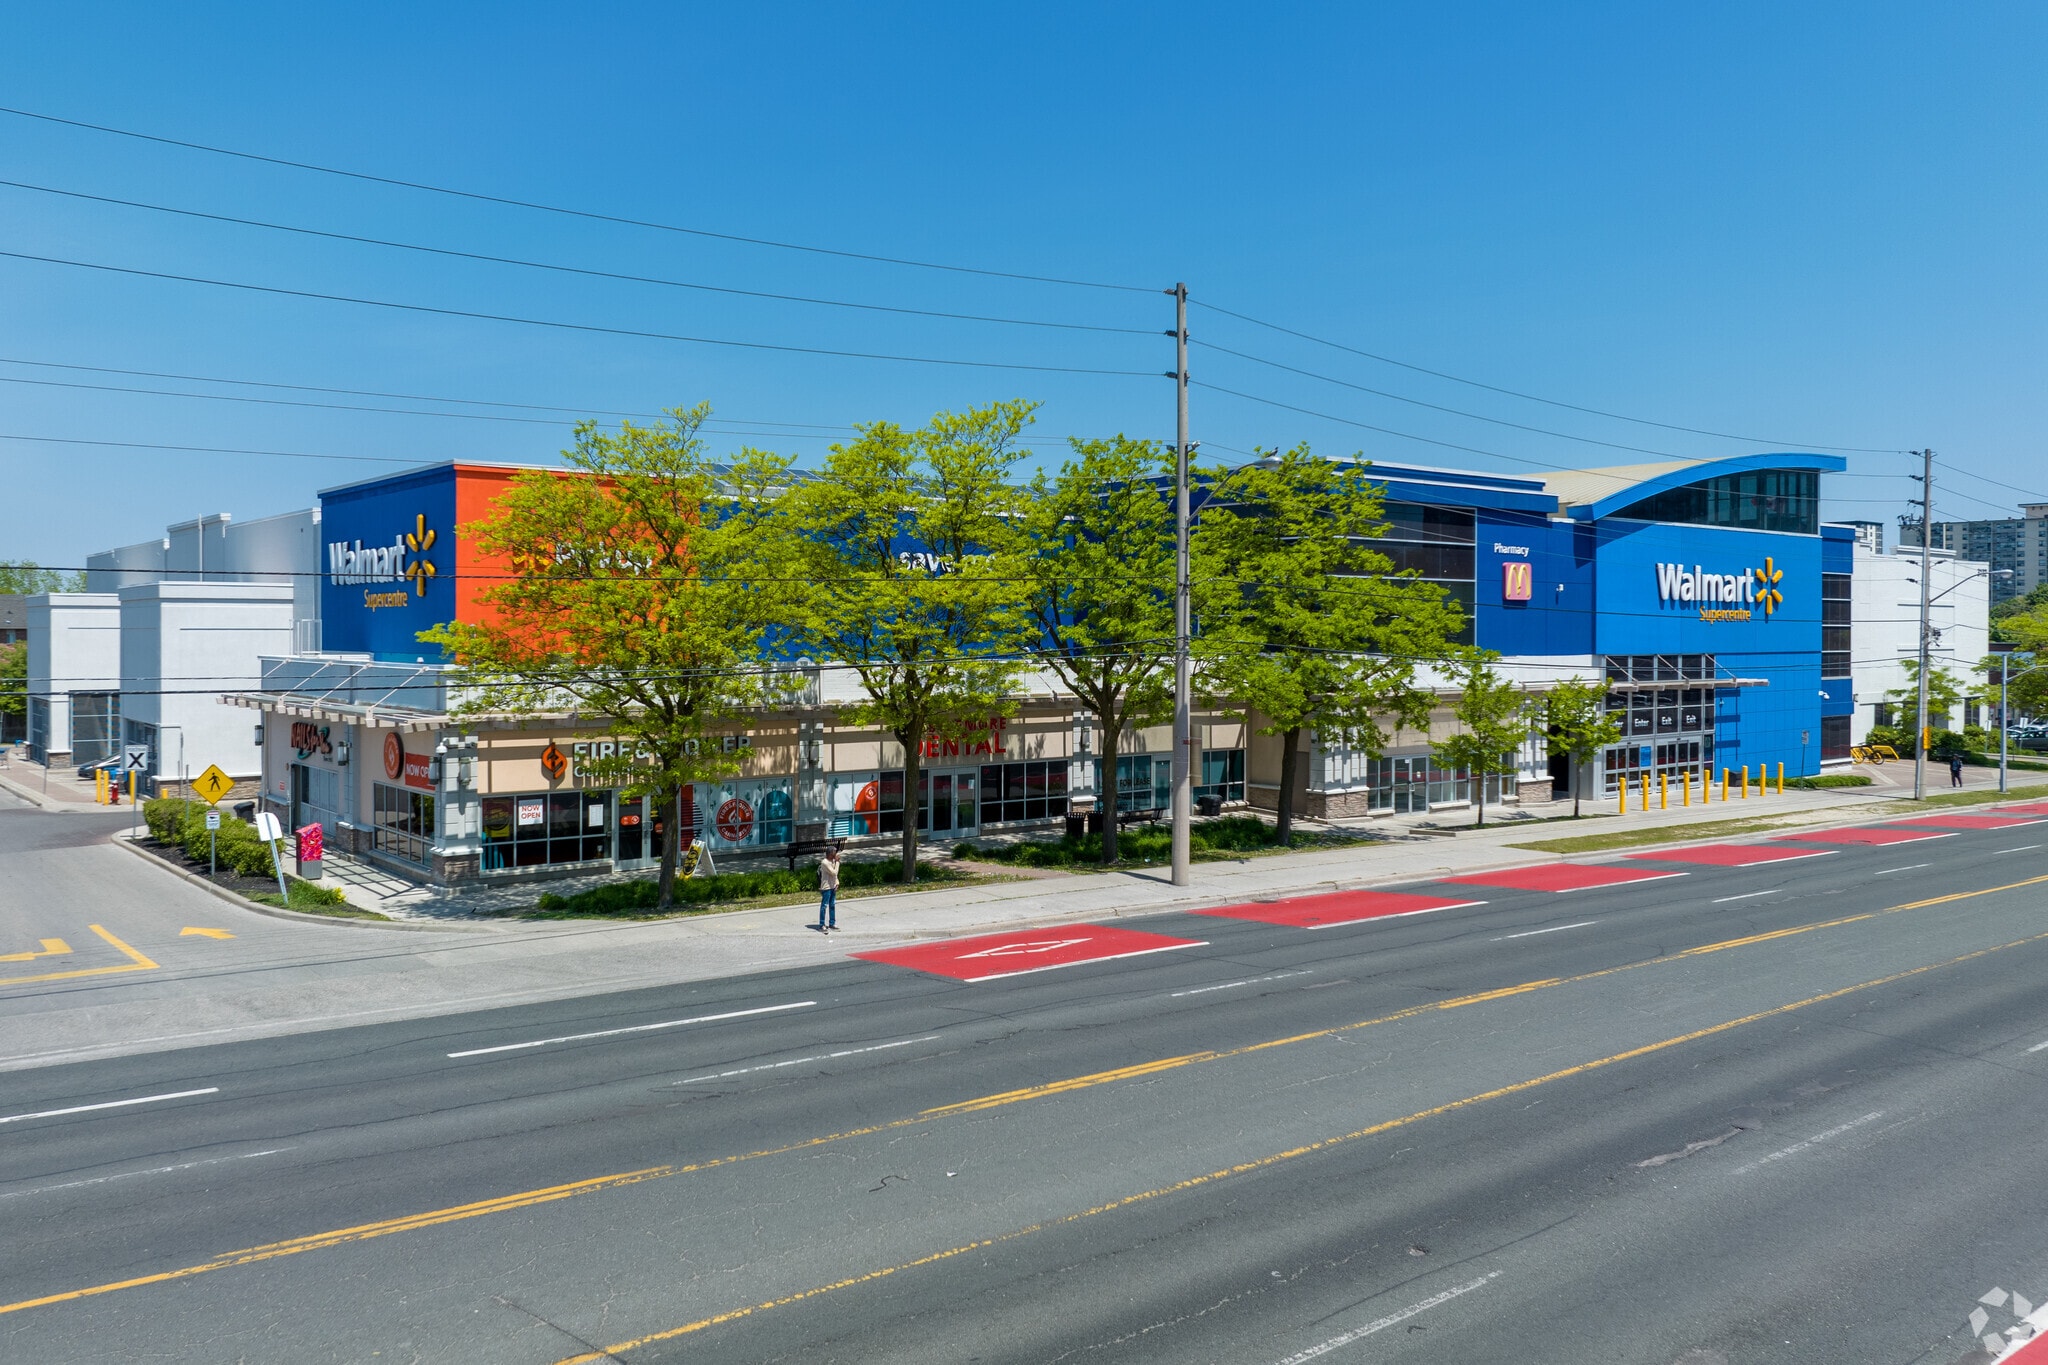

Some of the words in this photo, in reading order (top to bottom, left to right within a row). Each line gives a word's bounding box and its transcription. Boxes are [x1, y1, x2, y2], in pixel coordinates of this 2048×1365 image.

[1494, 543, 1529, 557] Pharmacy
[328, 535, 405, 586] Walmart
[1657, 563, 1754, 603] Walmart
[364, 589, 408, 612] Supercentre
[1700, 606, 1751, 624] Supercentre
[1634, 718, 1649, 727] Enter
[1661, 716, 1672, 725] Exit
[1686, 714, 1696, 723] Exit
[406, 765, 420, 776] NOW
